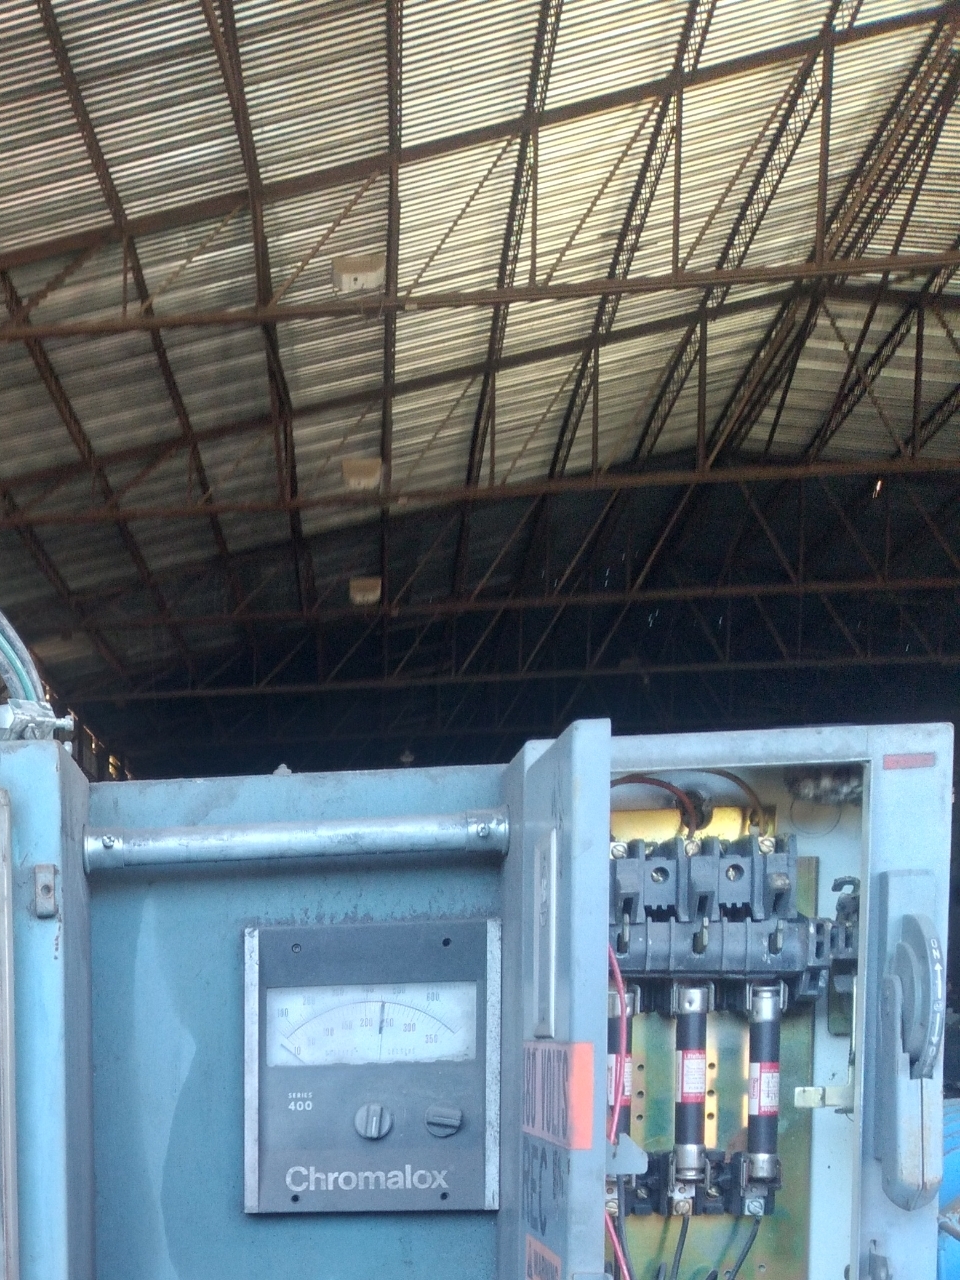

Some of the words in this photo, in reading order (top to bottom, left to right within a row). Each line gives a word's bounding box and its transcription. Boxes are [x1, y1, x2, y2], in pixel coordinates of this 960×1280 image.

[930, 939, 940, 959] ON
[427, 992, 440, 1002] 600
[277, 1008, 289, 1018] 100
[360, 1018, 373, 1028] 200
[403, 1023, 416, 1033] 300
[425, 1034, 438, 1044] 350
[294, 1047, 301, 1056] 10
[541, 1048, 568, 1140] VOLTS
[289, 1101, 313, 1111] 400
[285, 1164, 449, 1192] Chromalox
